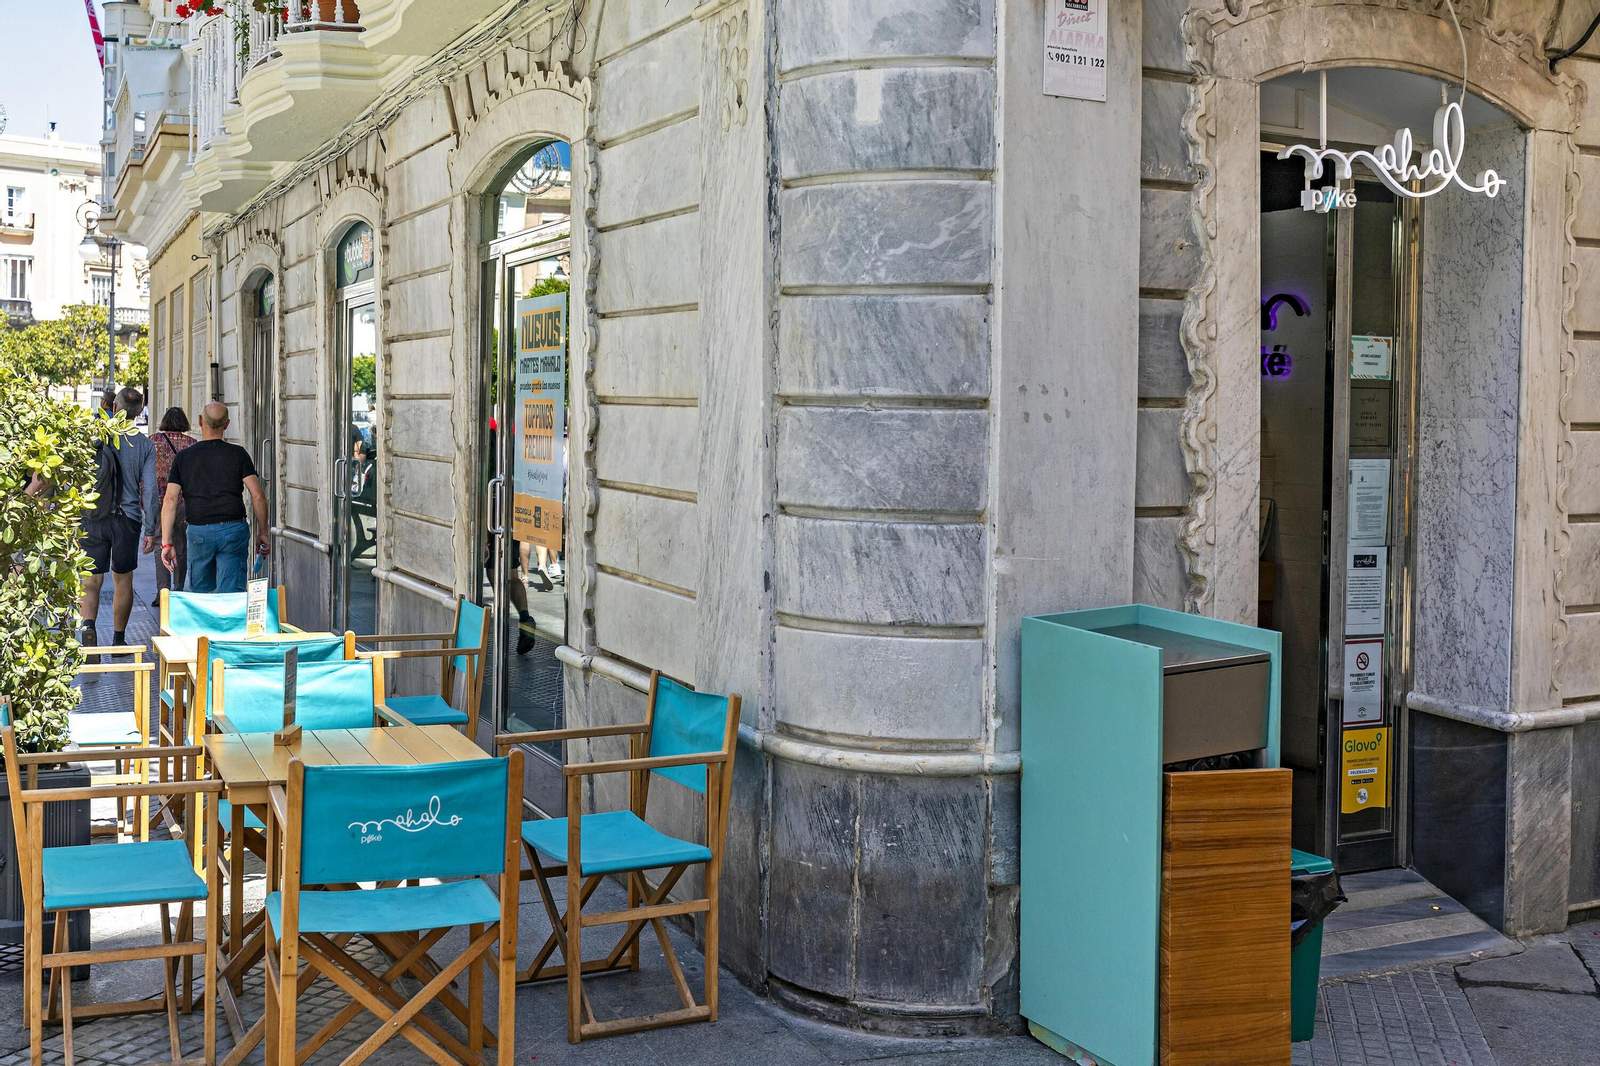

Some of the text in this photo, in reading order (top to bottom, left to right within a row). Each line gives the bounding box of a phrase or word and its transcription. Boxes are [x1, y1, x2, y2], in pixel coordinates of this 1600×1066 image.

[1057, 10, 1096, 28] Direct
[1055, 52, 1105, 68] 902 121 122
[1277, 102, 1507, 198] mahalo
[521, 310, 561, 350] NUEVOS
[520, 355, 561, 374] MARTES MAHALO
[524, 403, 554, 430] TOPPINGS
[524, 434, 553, 461] PREMIUM
[1344, 739, 1377, 753] Glovo
[347, 795, 464, 834] mahalo
